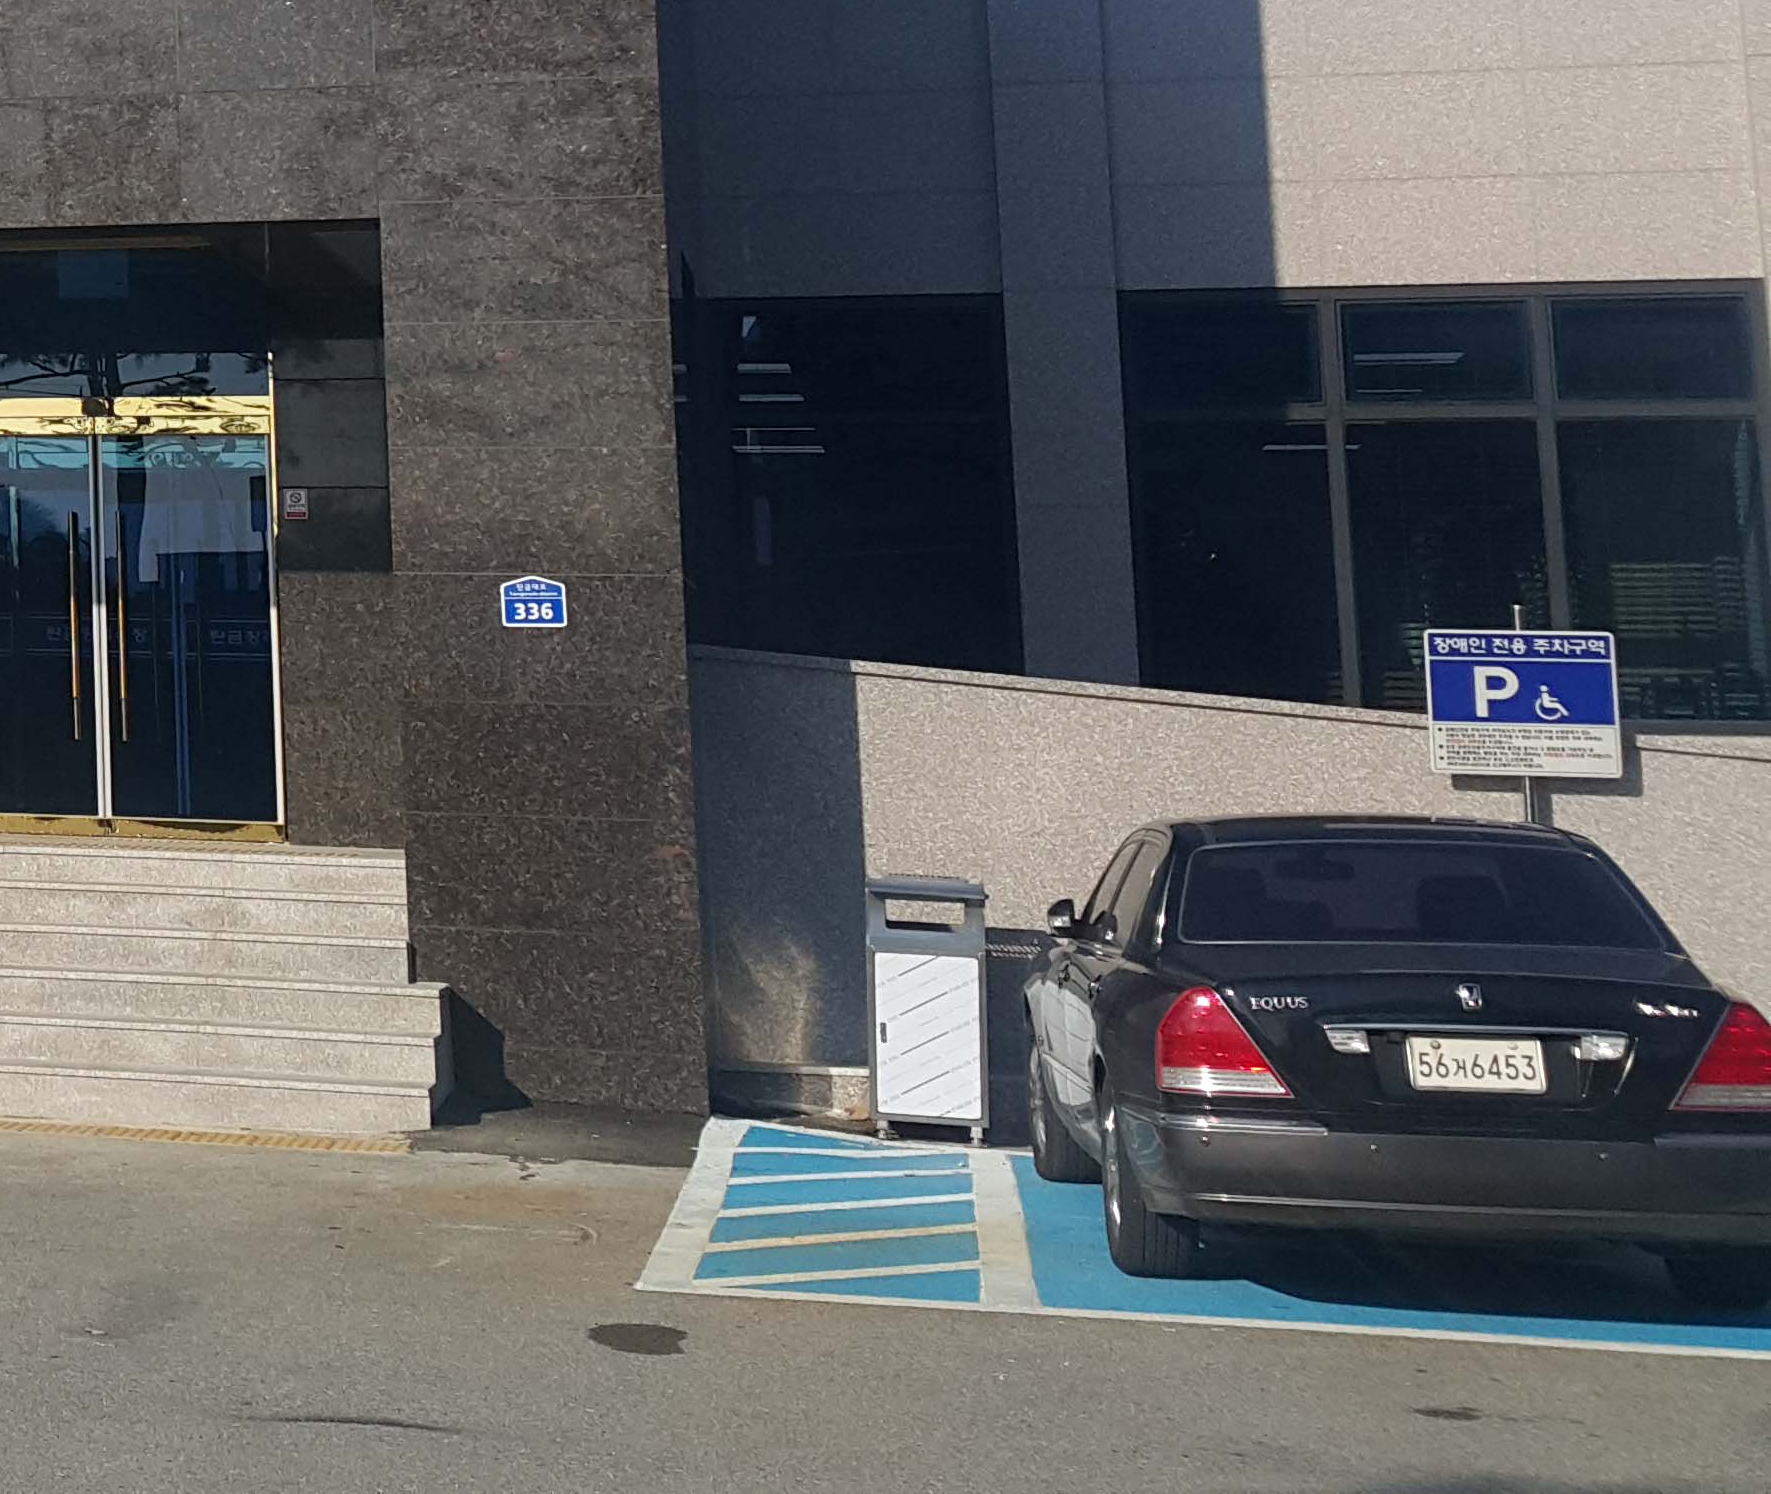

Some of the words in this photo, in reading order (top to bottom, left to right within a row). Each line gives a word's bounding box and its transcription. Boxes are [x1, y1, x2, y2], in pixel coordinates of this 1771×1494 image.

[514, 602, 554, 620] 336
[1433, 637, 1487, 654] 장애인
[1492, 637, 1528, 655] 전용
[1532, 638, 1607, 656] 주차구역
[1473, 665, 1520, 718] P
[1249, 995, 1309, 1012] EQUUS
